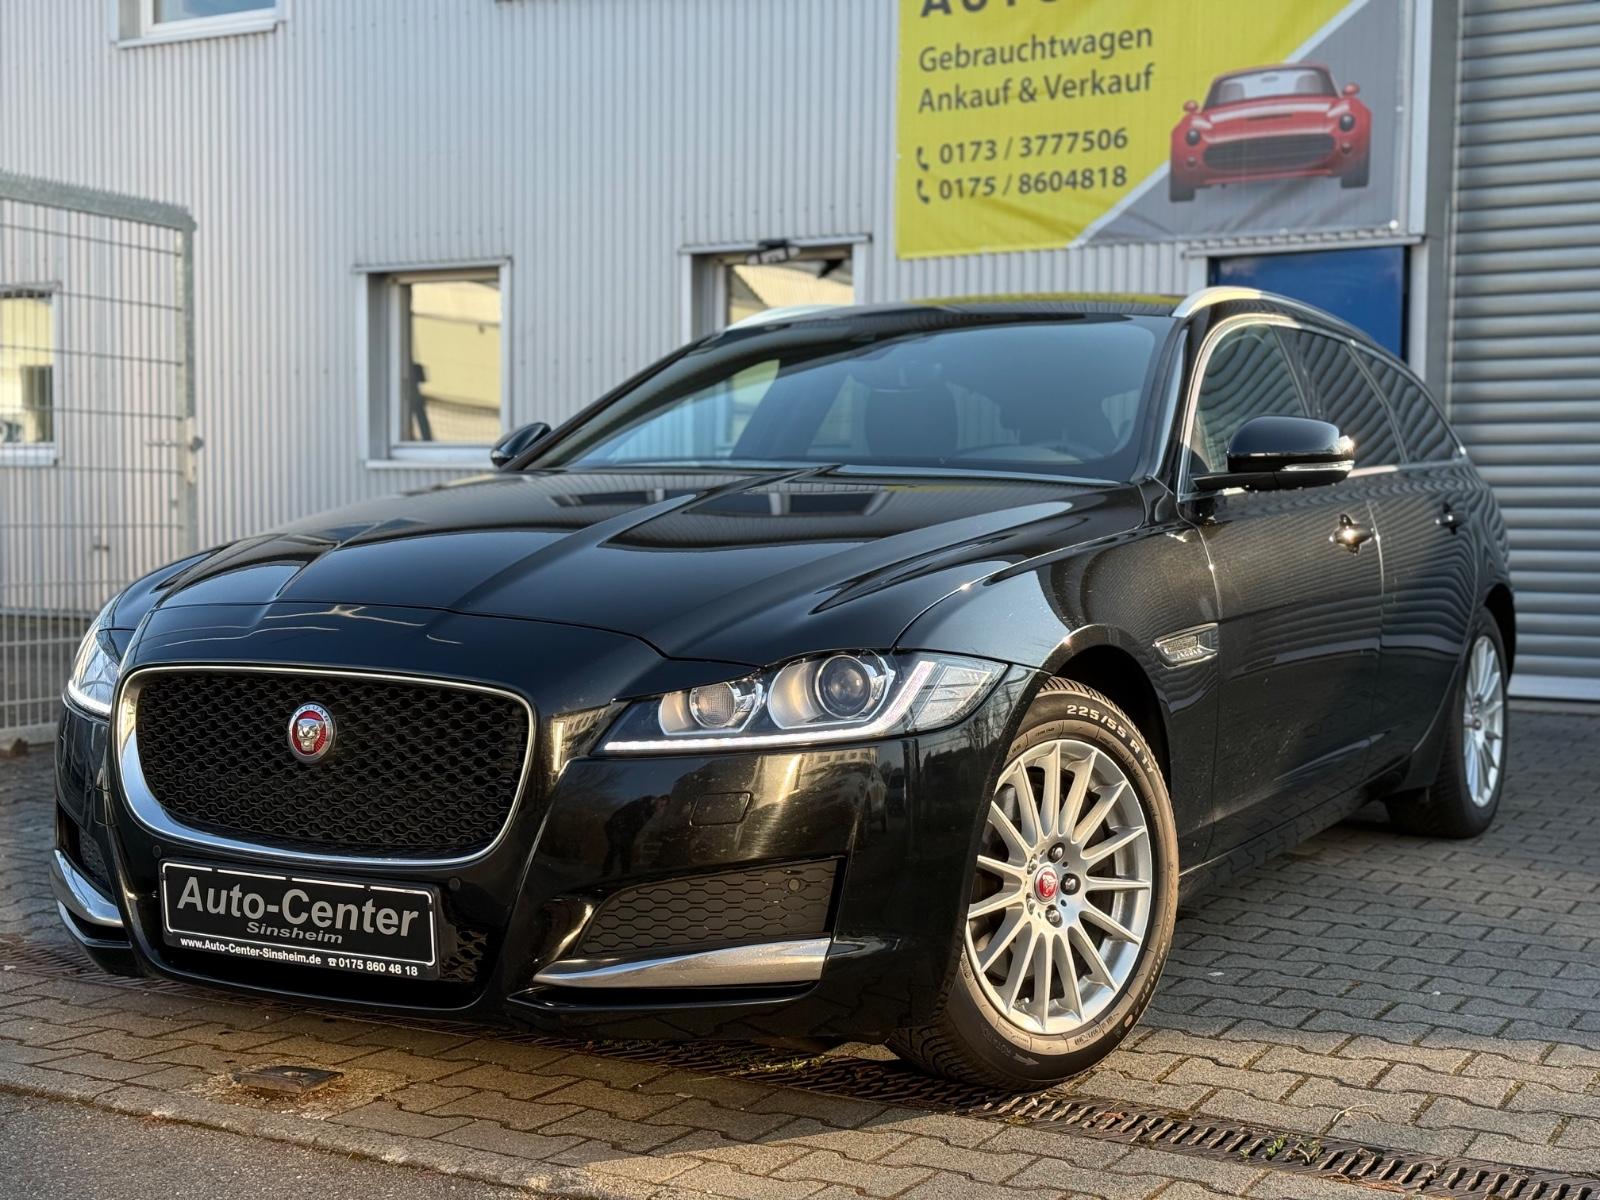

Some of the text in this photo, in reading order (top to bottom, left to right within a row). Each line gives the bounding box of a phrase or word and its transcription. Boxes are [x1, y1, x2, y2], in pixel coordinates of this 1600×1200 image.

[918, 27, 1153, 72] Gebrauchtwagen
[918, 62, 1155, 114] Ankauf & Verkauf
[939, 127, 1129, 165] 0173 / 3777506
[938, 165, 1128, 200] 0175 / 8604818
[1066, 704, 1127, 738] 225/55
[1129, 739, 1141, 754] R
[177, 876, 420, 937] Auto-Center
[246, 921, 343, 945] Sinsheim
[180, 938, 418, 976] www.Auto-Center-Sinsheim.de 0175 860 48 18
